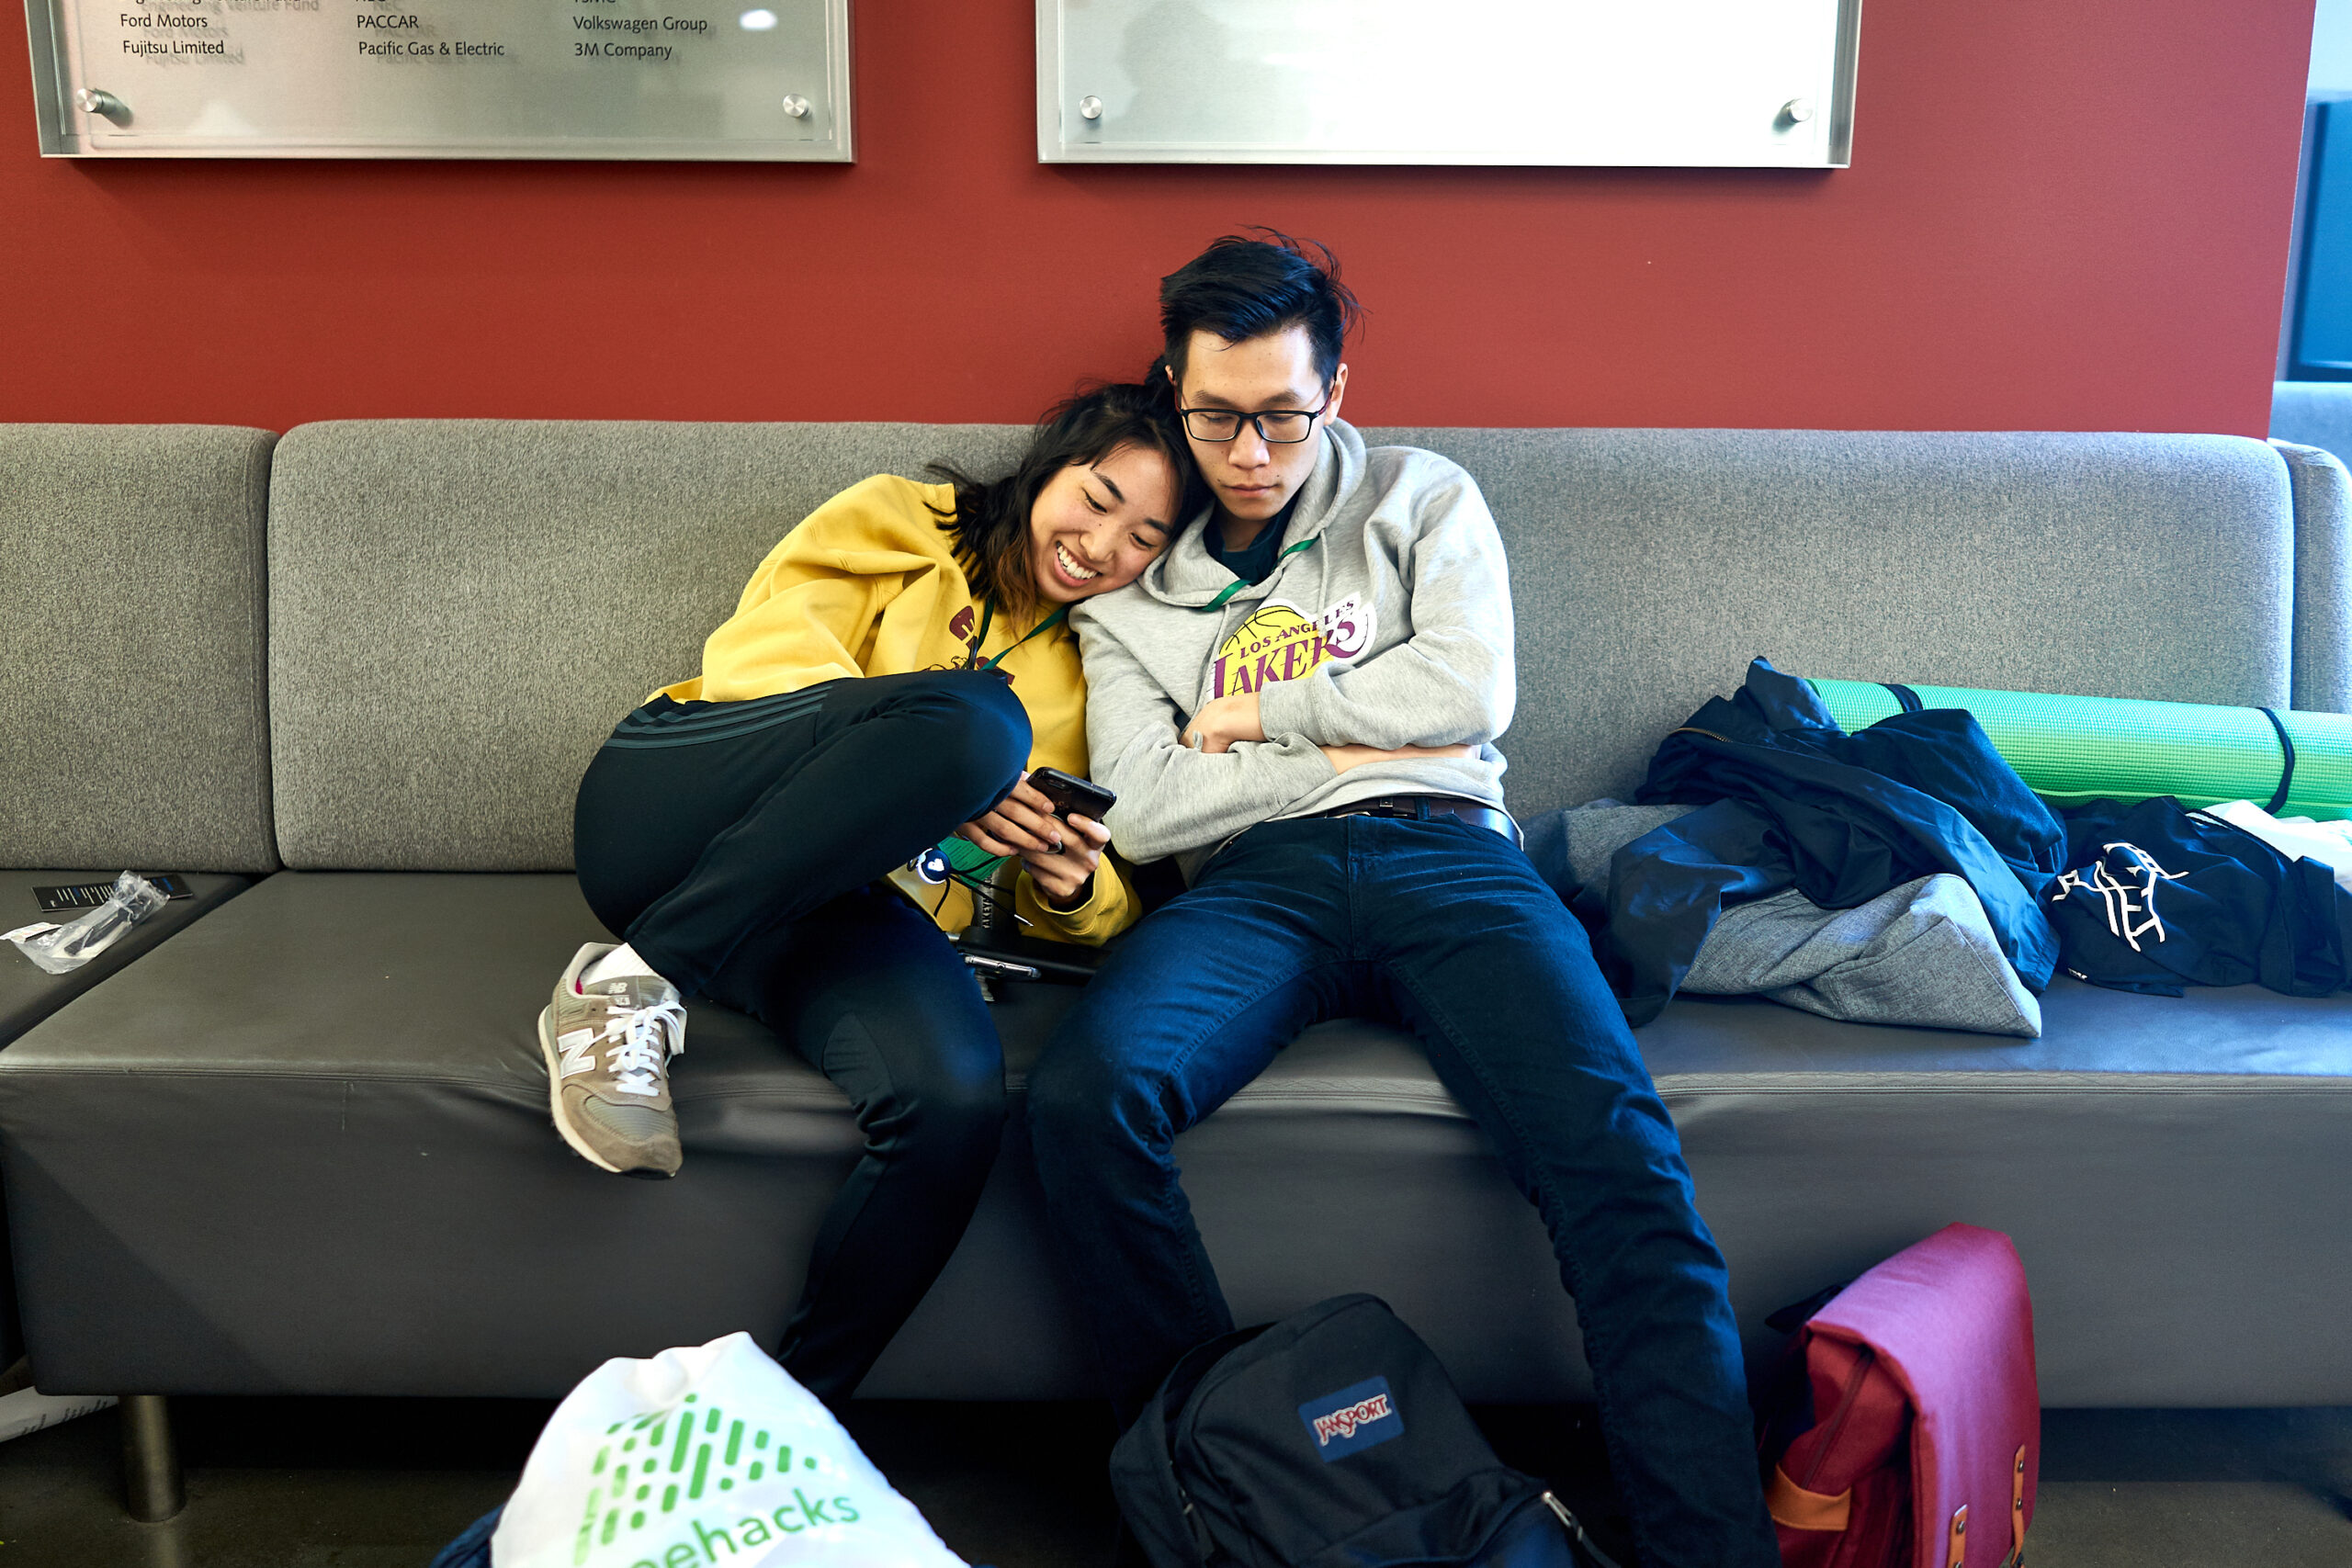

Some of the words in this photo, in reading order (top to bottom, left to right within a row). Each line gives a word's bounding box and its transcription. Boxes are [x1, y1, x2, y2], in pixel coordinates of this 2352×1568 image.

[120, 14, 152, 28] Ford
[156, 14, 208, 28] Motors
[356, 15, 419, 28] PACCAR
[572, 16, 658, 34] Volkswagen
[662, 16, 707, 34] Group
[123, 40, 168, 57] Fujitsu
[173, 39, 225, 54] Limited
[358, 40, 403, 56] Pacific
[408, 41, 435, 56] Gas
[438, 42, 450, 56] &
[456, 41, 505, 56] Electric
[574, 43, 599, 57] 3M
[604, 42, 673, 61] Company
[1240, 637, 1271, 659] LOS
[558, 1028, 596, 1078] N
[631, 1487, 861, 1568] ehacks
